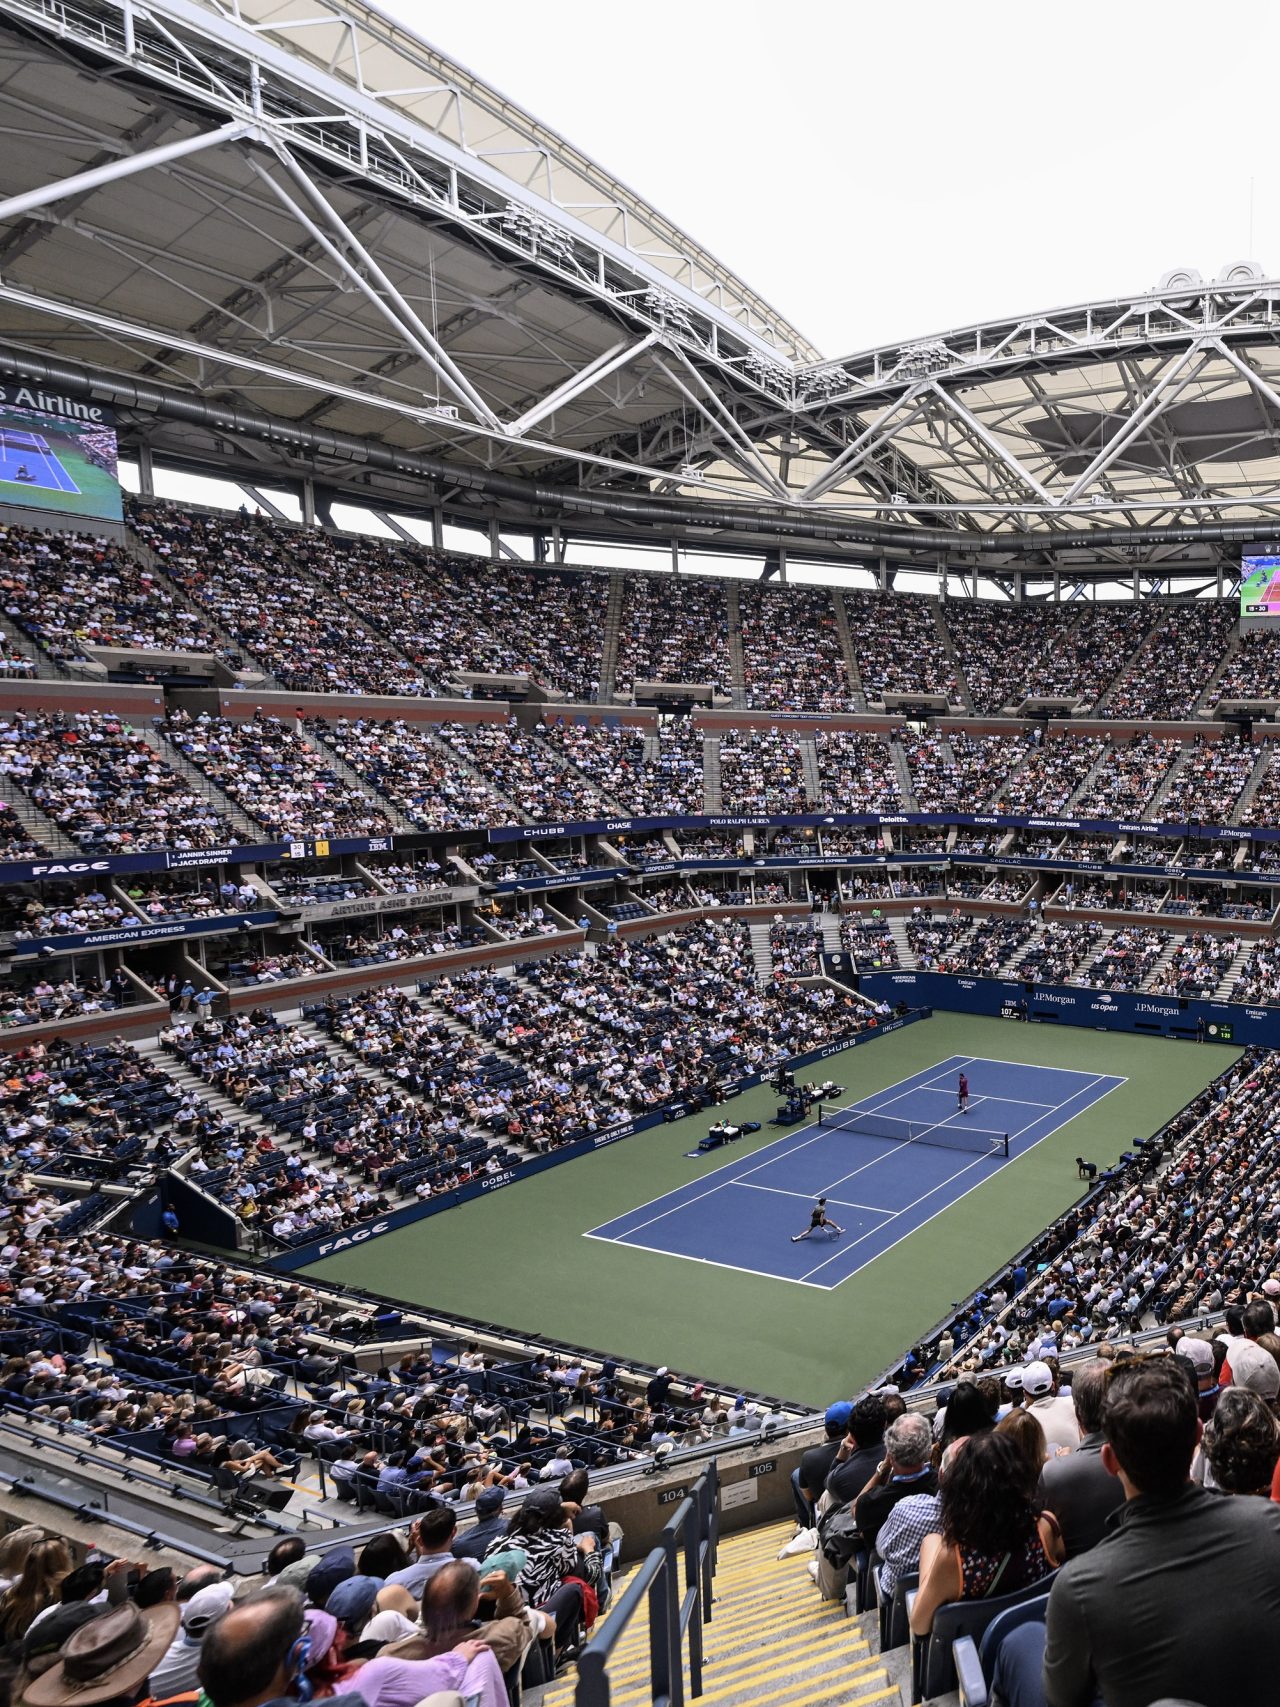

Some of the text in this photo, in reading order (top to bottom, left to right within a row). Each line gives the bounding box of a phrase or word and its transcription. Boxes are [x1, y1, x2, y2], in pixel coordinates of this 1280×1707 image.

[15, 387, 103, 422] Airline
[524, 828, 564, 836] CHUBB
[607, 822, 632, 830] CHASE
[1219, 829, 1251, 838] J.P.Morgan
[369, 842, 388, 851] IBM
[32, 862, 110, 875] FAGE
[645, 864, 674, 872] USOPEN.ORG
[331, 893, 453, 916] ARTHUR ASHE STADIUM
[84, 925, 185, 943] AMERICAN EXPRESS
[1034, 992, 1076, 1005] J.P.Morgan
[1134, 1003, 1179, 1016] J.P.Morgan
[883, 1024, 893, 1032] IHG
[822, 1038, 856, 1057] CHUBB
[482, 1171, 516, 1188] DOBEL
[491, 1180, 510, 1189] TEQUILA
[319, 1222, 389, 1256] FAGE
[754, 1462, 772, 1475] 105
[663, 1488, 685, 1503] 104
